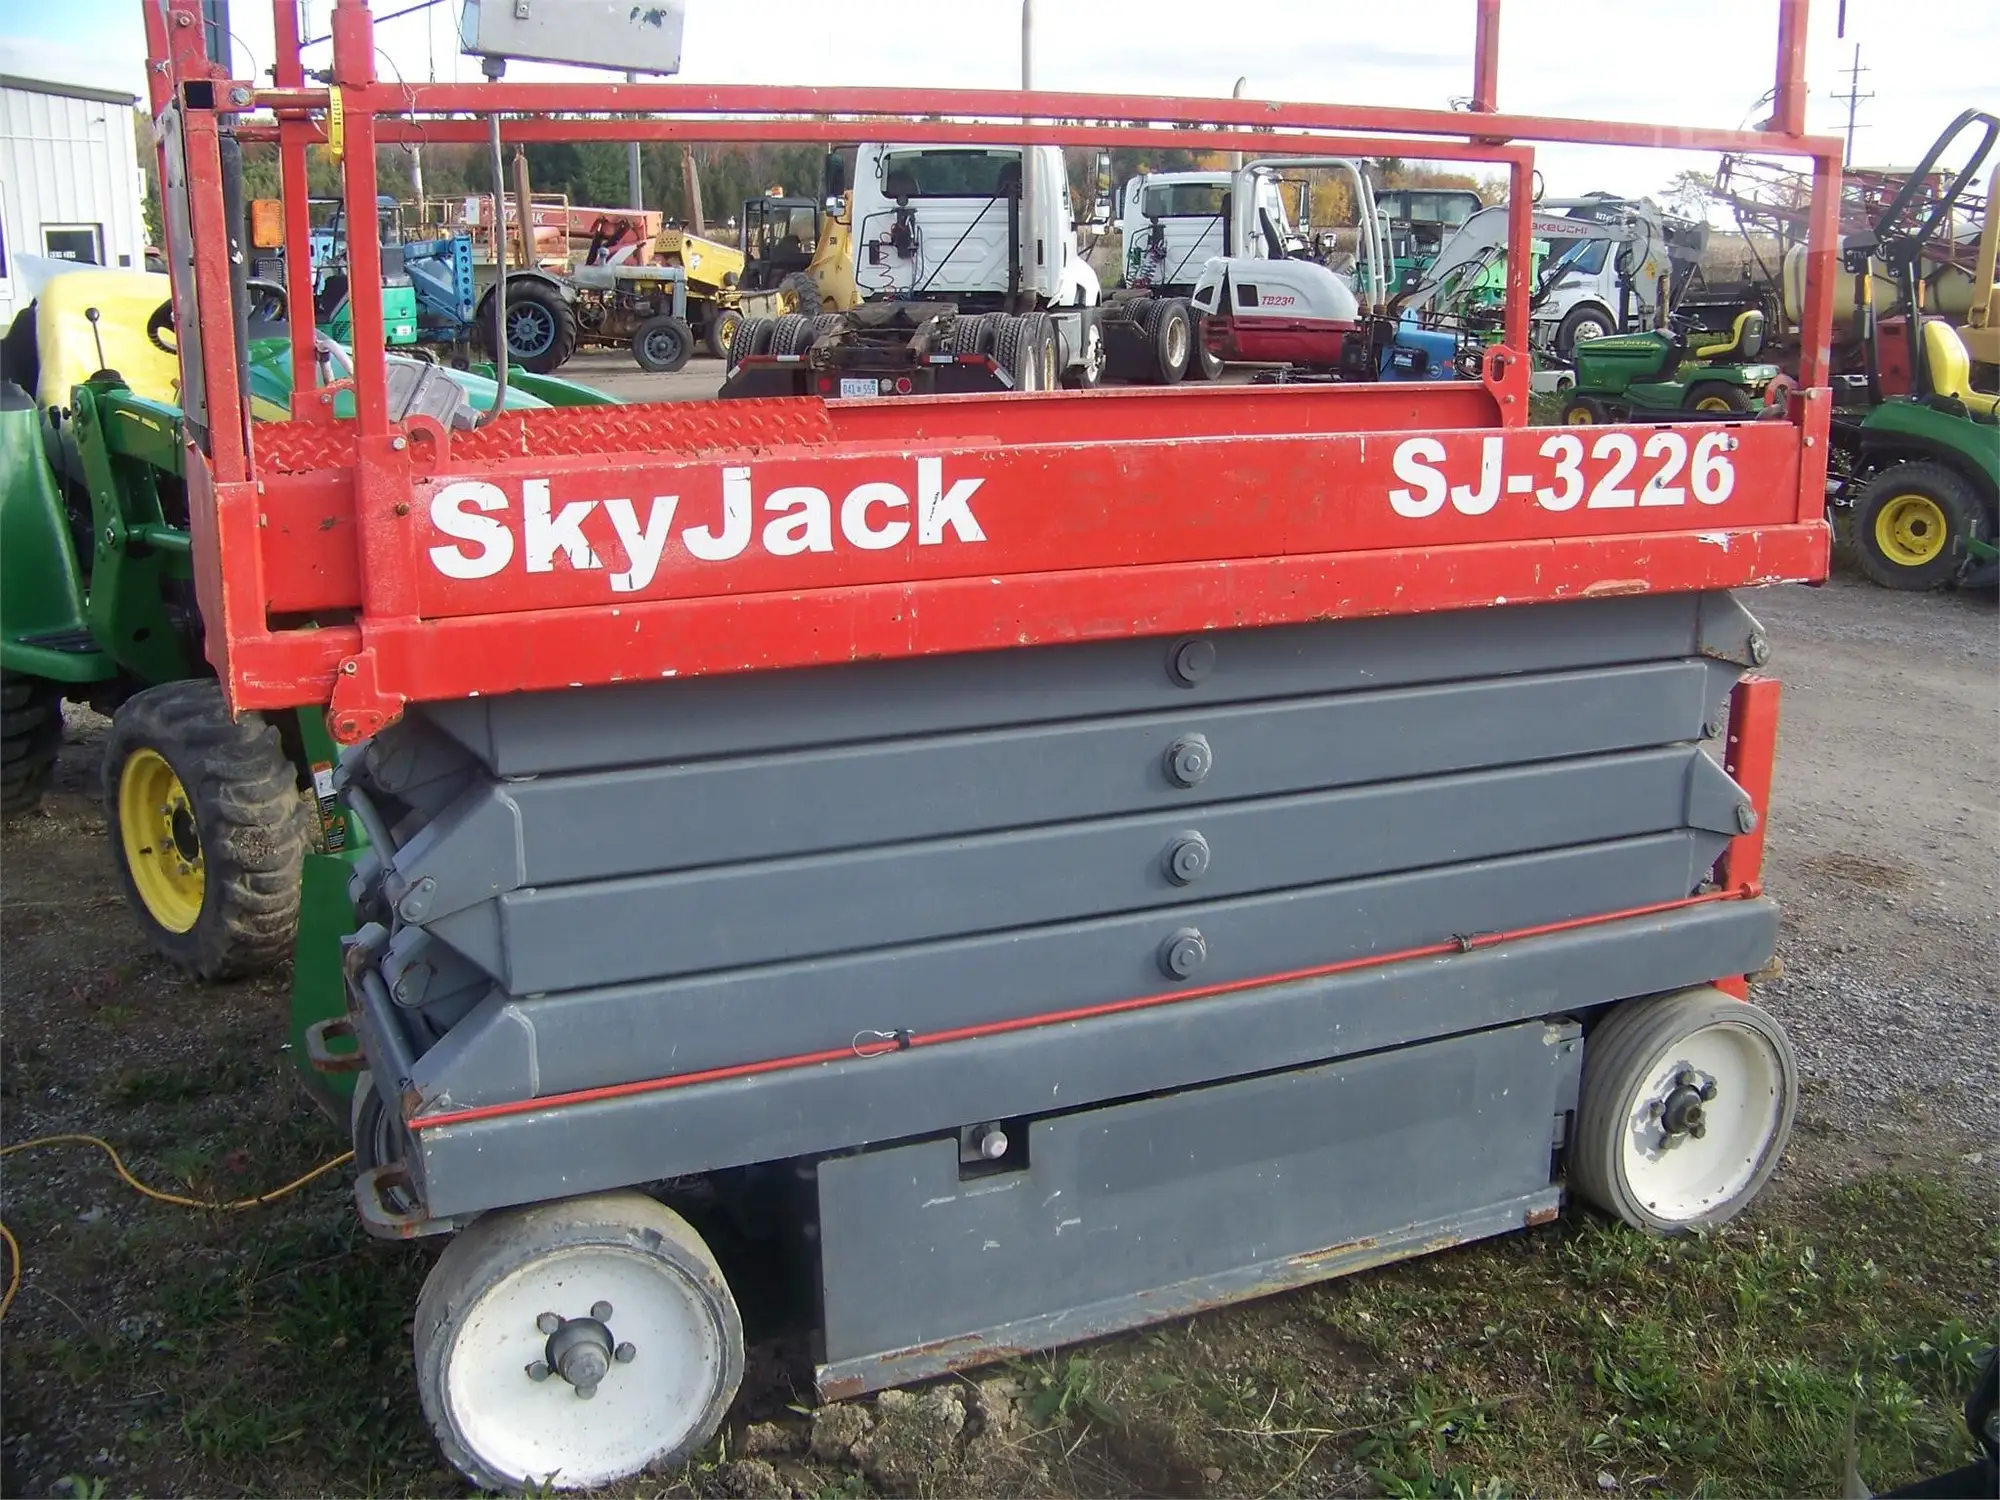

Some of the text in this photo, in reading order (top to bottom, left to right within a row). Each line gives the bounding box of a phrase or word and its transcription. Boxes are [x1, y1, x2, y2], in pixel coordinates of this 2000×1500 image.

[1531, 222, 1588, 235] AKEUCHI
[1388, 431, 1735, 519] SJ-3226
[429, 457, 988, 592] SkyJack
